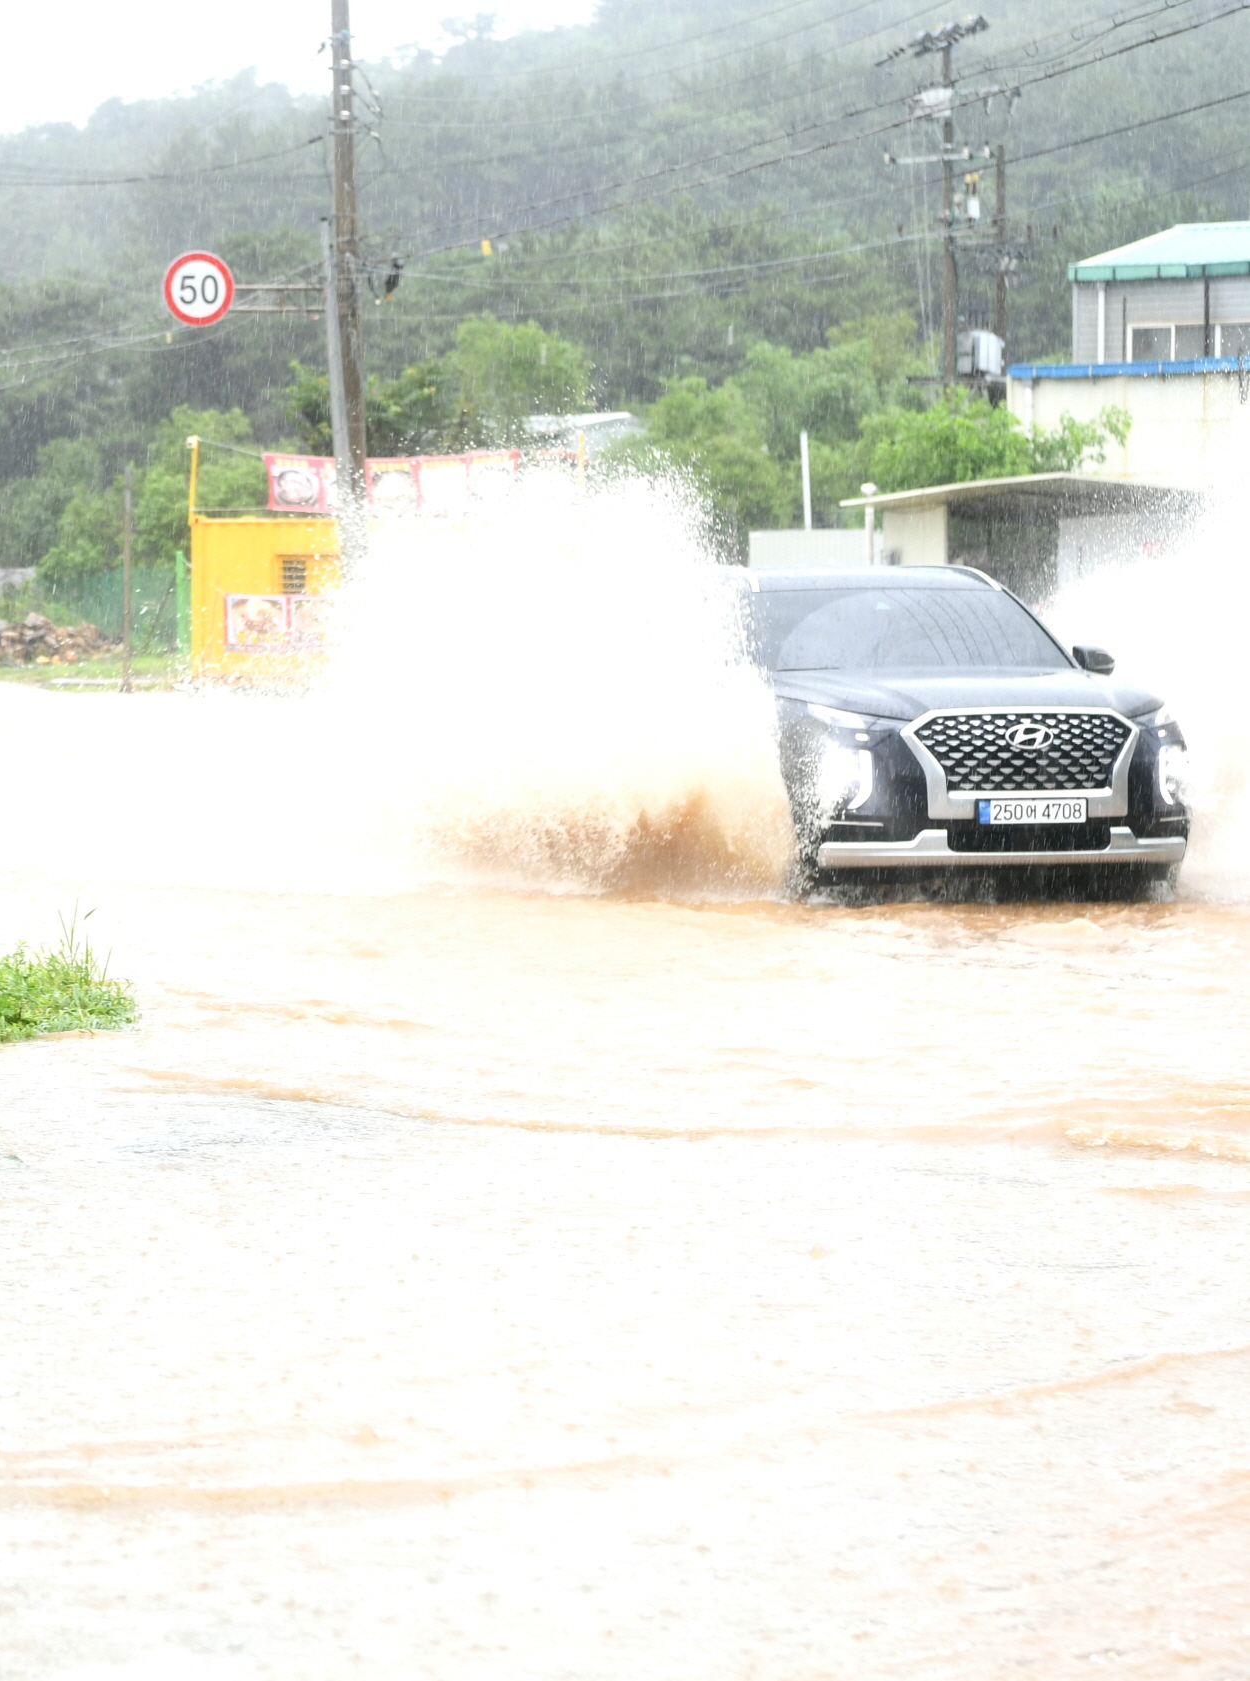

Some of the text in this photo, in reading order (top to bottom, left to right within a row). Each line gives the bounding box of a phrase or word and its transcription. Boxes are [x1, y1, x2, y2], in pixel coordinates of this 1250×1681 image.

[179, 275, 219, 305] 50
[993, 802, 1083, 821] 250어 4708
